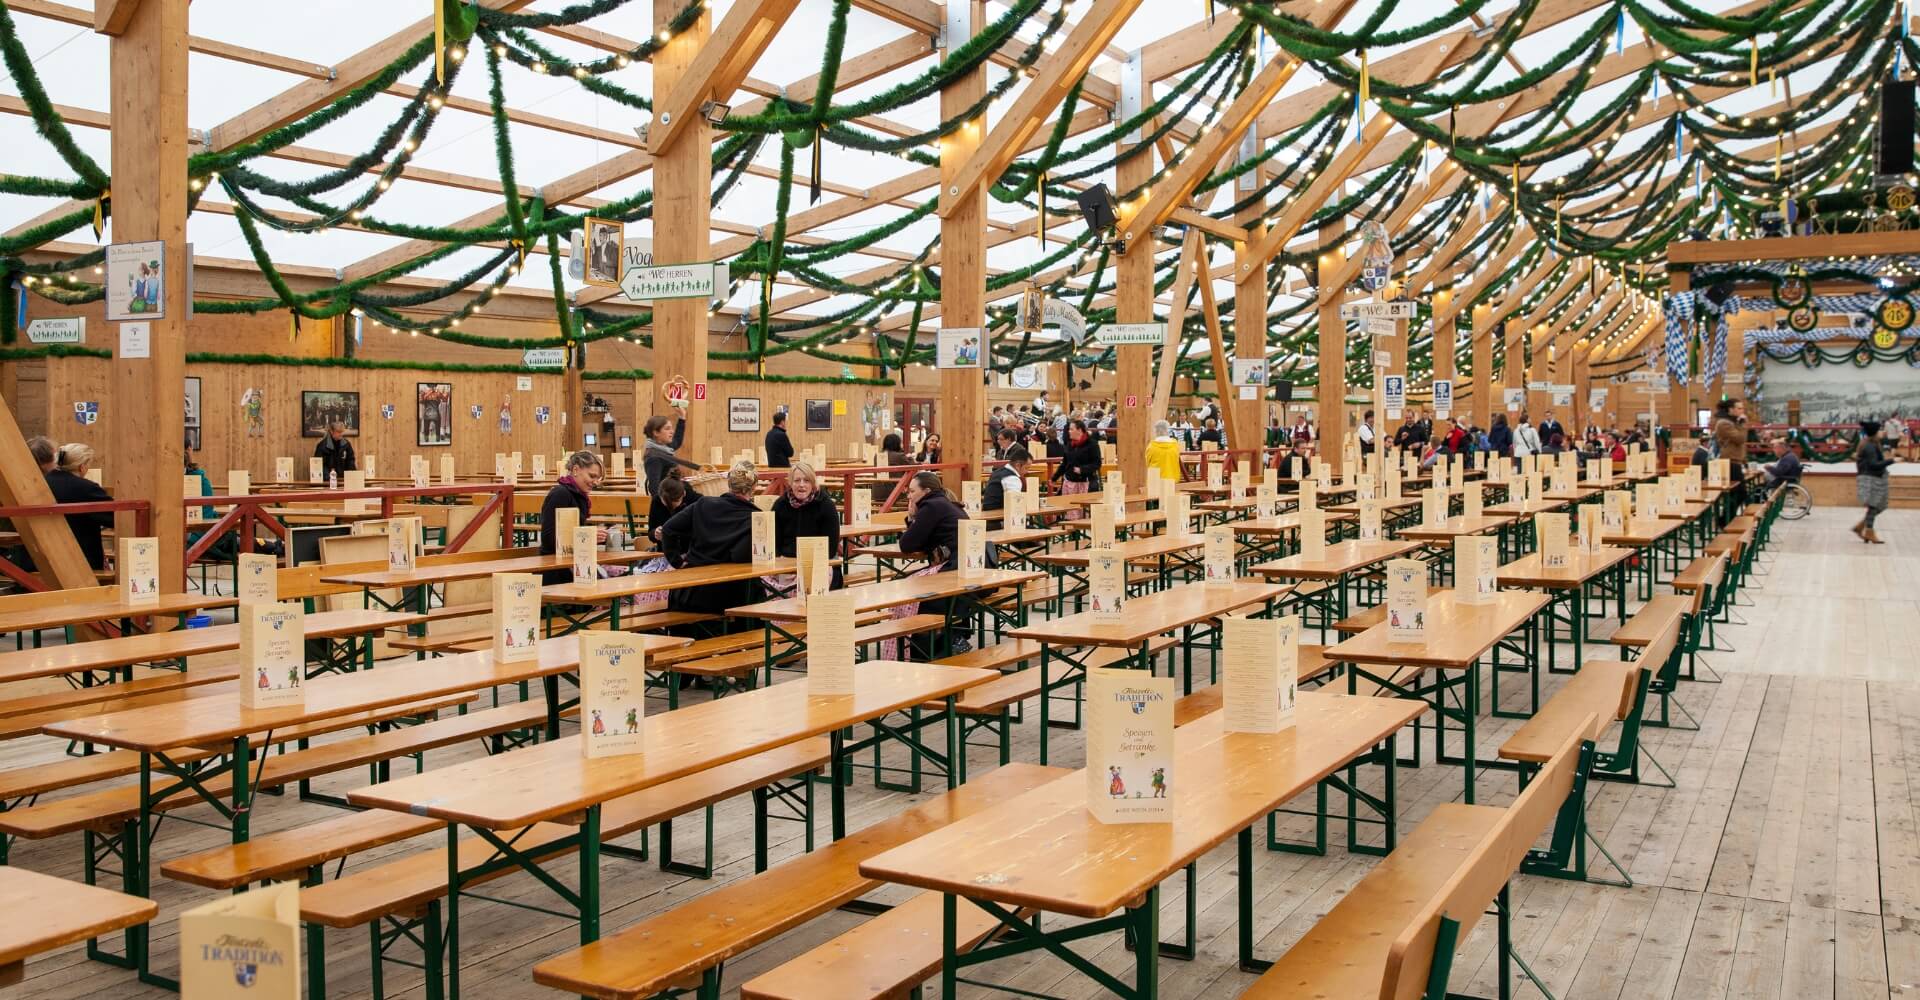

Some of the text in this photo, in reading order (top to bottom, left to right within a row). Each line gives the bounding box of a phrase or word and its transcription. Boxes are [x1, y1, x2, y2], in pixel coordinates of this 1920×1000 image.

[649, 269, 693, 280] WC HERREN
[1366, 305, 1384, 316] WC
[595, 647, 636, 657] TRADITION
[1114, 693, 1164, 703] TRADITION
[1122, 727, 1154, 740] Speisen
[201, 944, 284, 966] TRADITION
